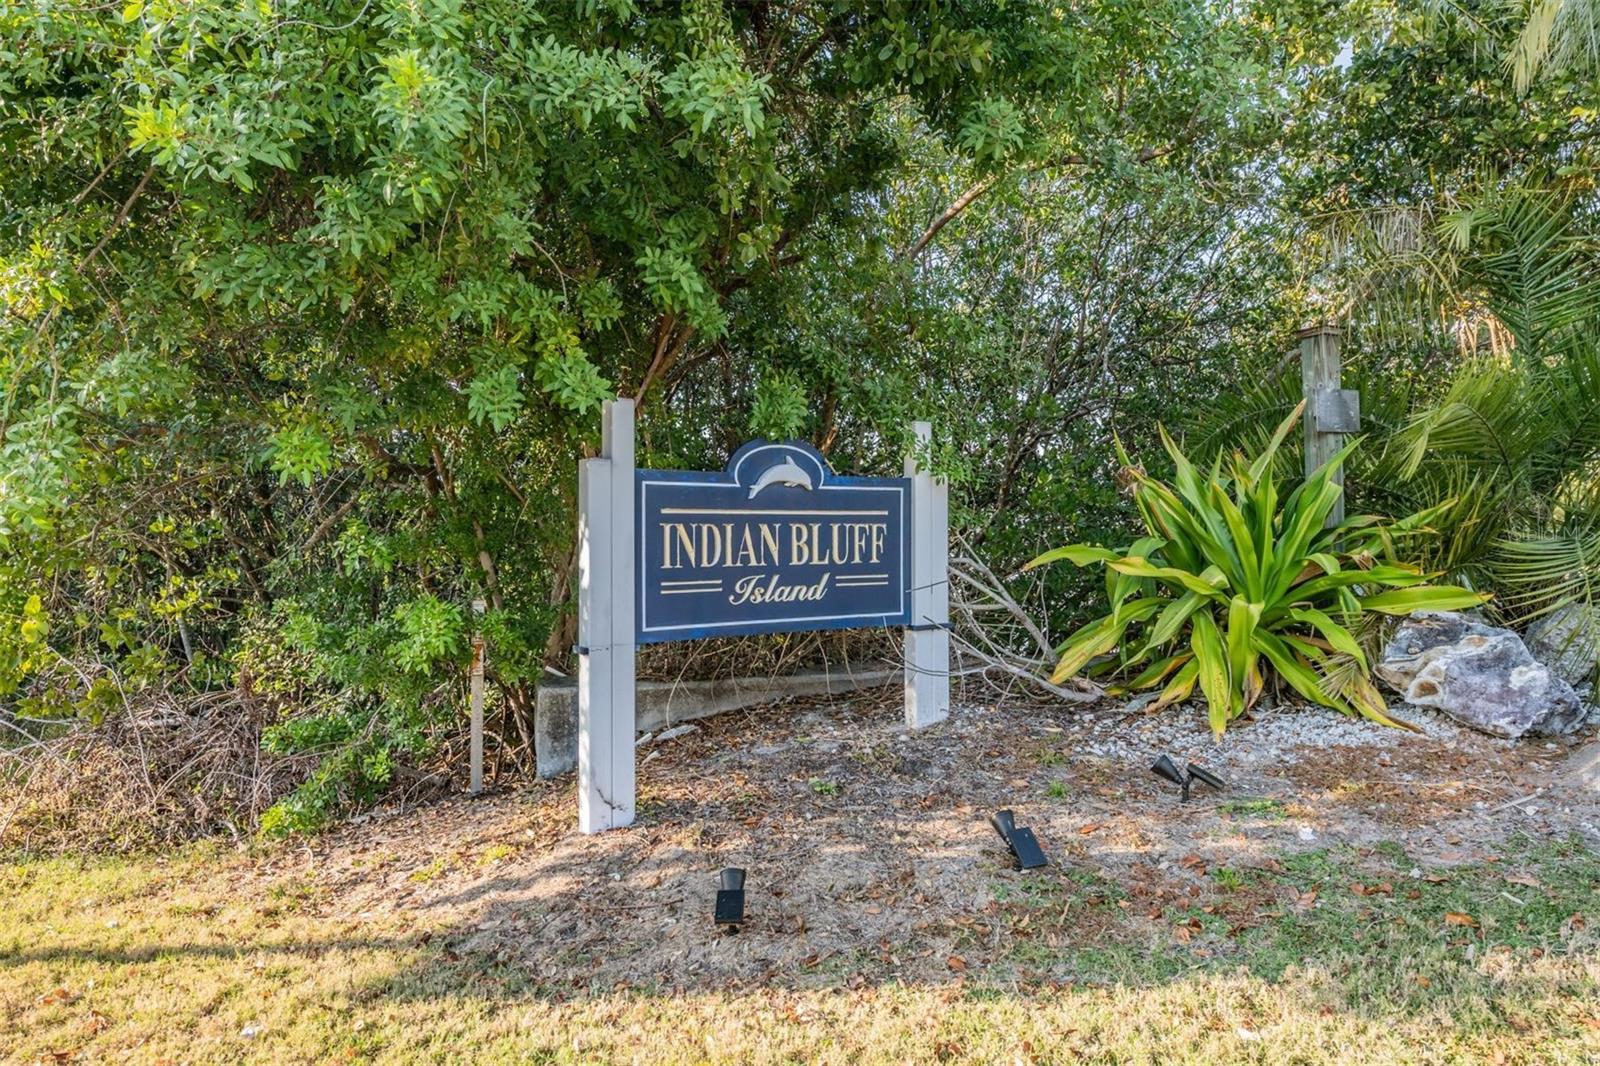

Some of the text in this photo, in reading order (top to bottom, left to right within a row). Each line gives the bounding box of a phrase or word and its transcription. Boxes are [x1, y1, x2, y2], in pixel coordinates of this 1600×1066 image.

[660, 523, 887, 569] INDIAN BLUFF
[728, 572, 831, 605] Island
